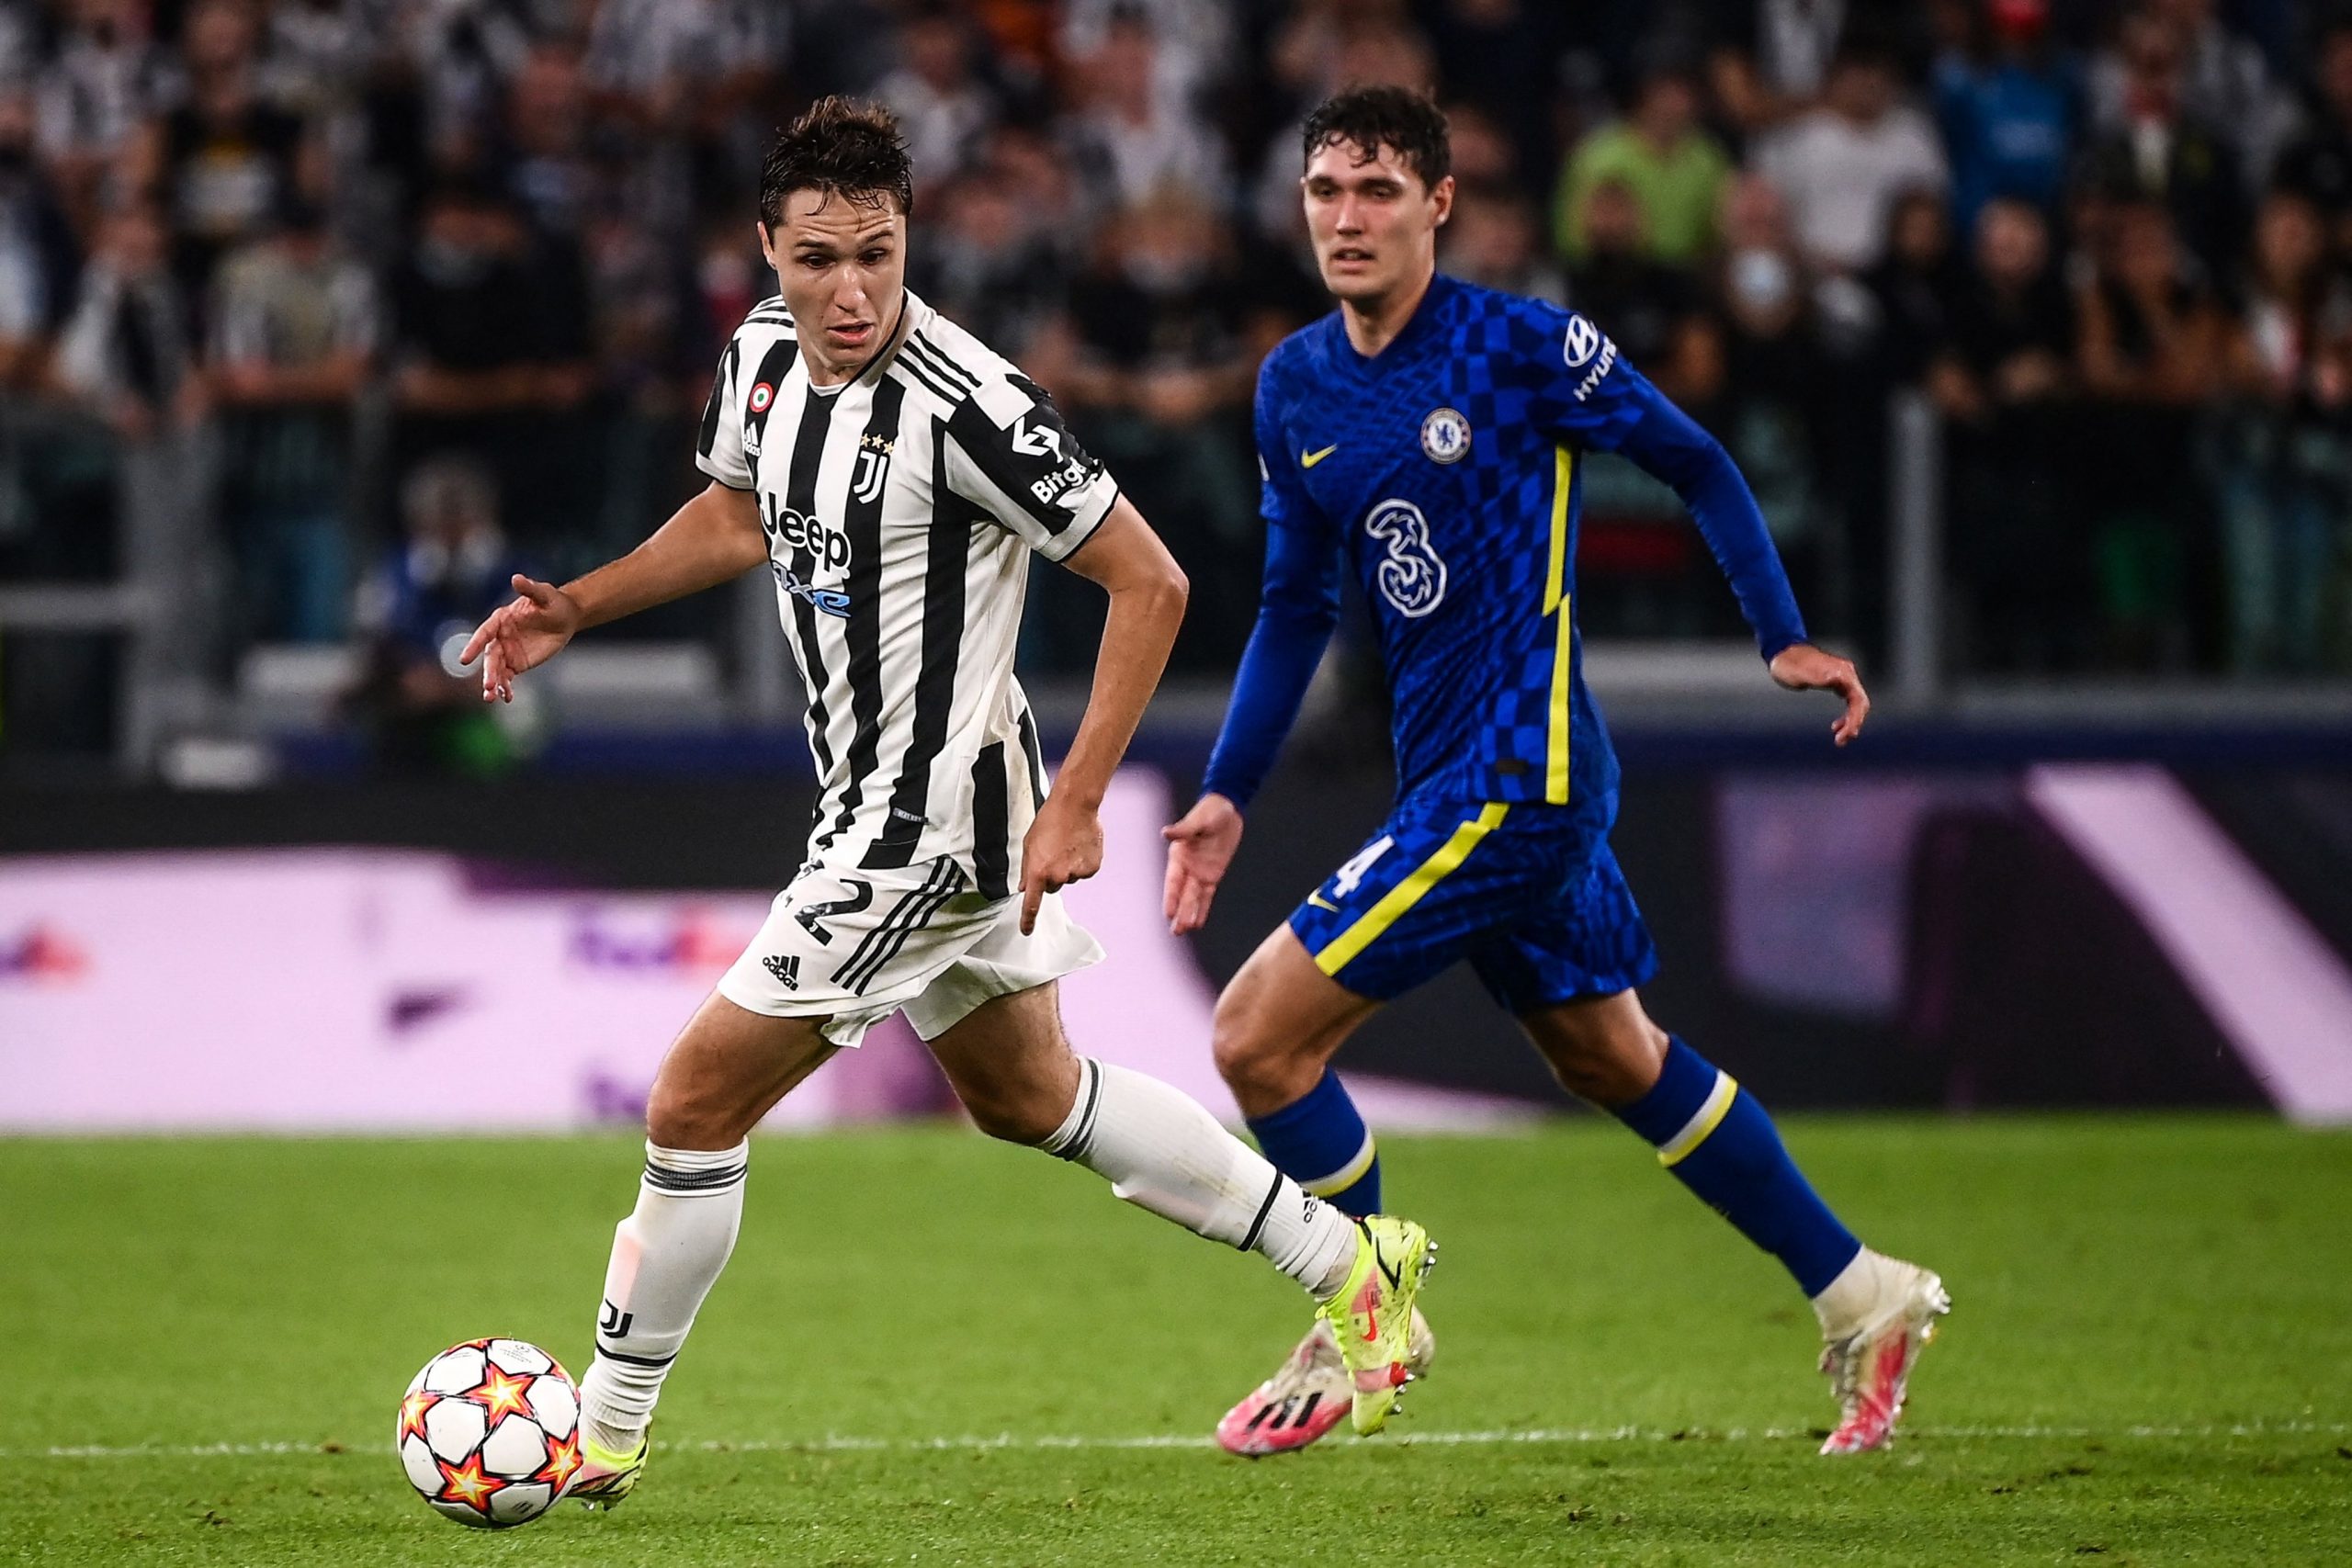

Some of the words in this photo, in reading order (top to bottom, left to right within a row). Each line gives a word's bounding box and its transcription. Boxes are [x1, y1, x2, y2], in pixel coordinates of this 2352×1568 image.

[761, 491, 849, 573] Jeep
[1332, 834, 1396, 899] 4
[763, 956, 798, 991] adidas
